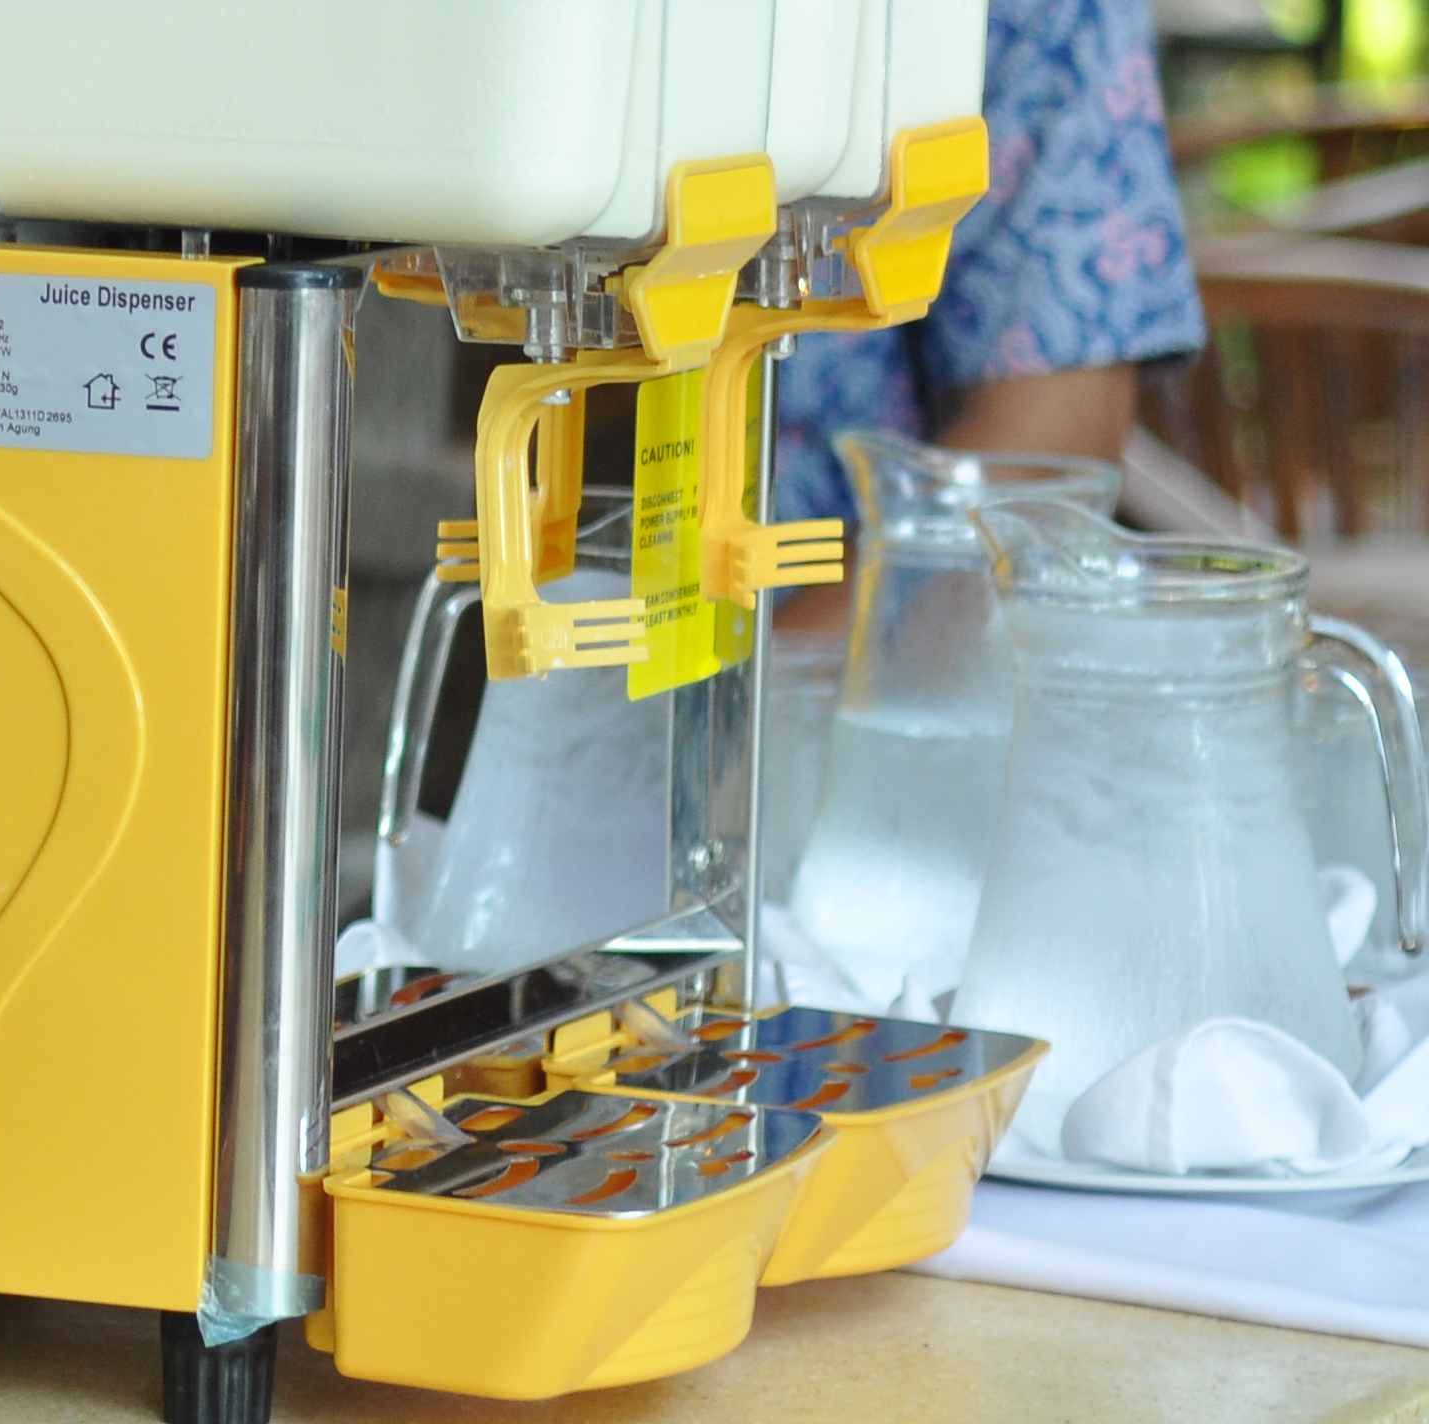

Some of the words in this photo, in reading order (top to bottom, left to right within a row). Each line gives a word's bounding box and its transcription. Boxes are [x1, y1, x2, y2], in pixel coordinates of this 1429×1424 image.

[39, 282, 91, 306] Juice
[97, 285, 196, 314] Dispenser
[1, 371, 10, 381] N
[7, 422, 41, 437] Agung
[641, 438, 695, 466] CAUTION!
